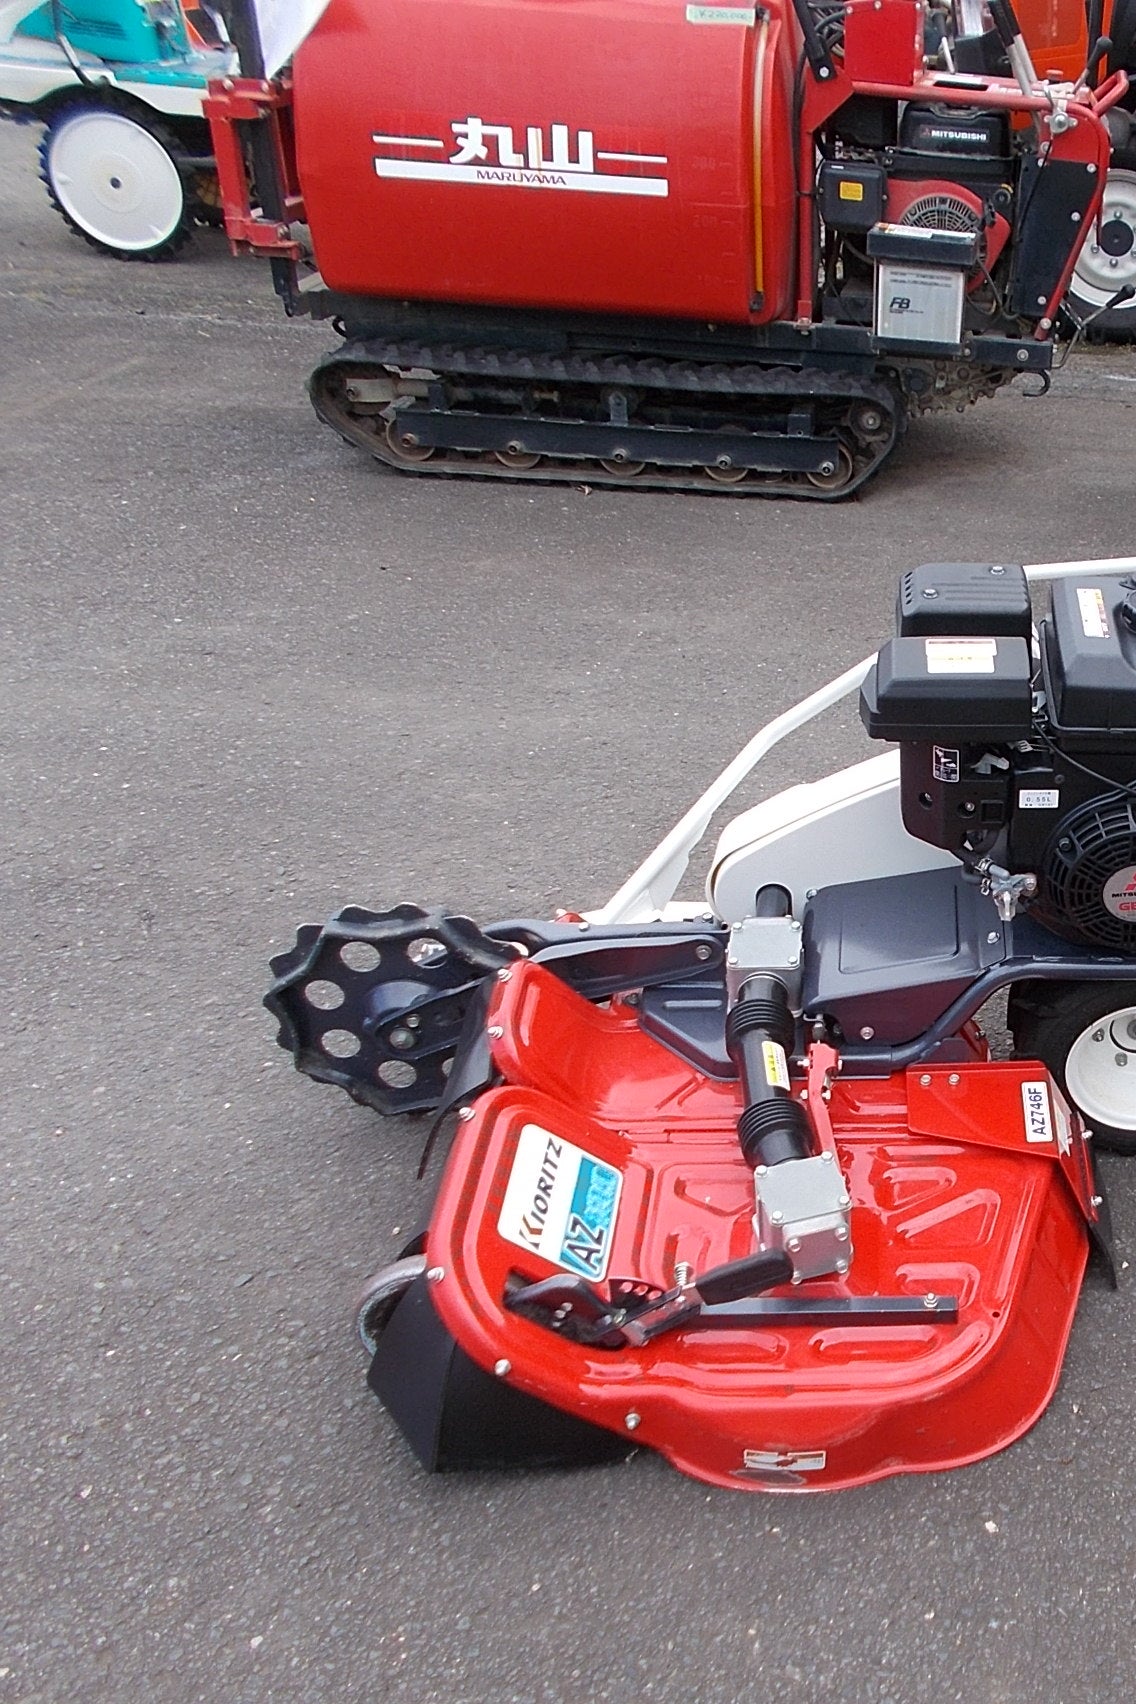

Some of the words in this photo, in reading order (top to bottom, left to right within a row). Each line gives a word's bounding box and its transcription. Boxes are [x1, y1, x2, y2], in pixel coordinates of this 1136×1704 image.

[449, 116, 594, 173] 丸山
[931, 129, 987, 142] MITSUBISHI
[476, 169, 567, 186] MARUYAMA
[889, 297, 911, 309] FB
[1027, 1087, 1047, 1136] AZ746F
[518, 1137, 563, 1250] KIORITZ
[567, 1215, 605, 1271] AZ
